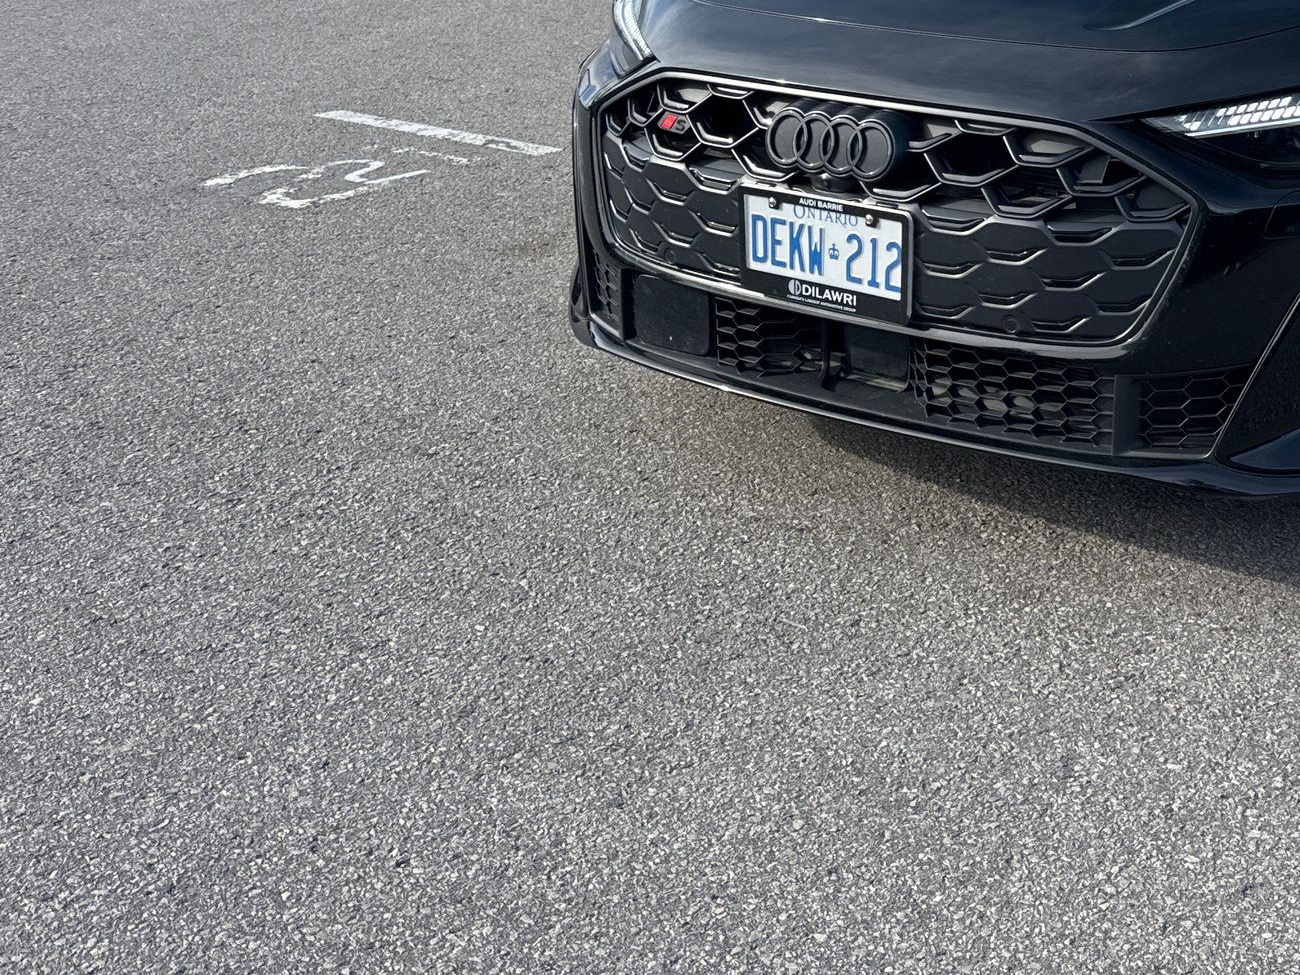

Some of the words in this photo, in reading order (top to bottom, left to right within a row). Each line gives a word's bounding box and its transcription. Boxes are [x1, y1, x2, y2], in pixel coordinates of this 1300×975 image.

[793, 204, 858, 228] ONTARIO
[799, 197, 816, 207] AUDI
[817, 200, 844, 212] BARRIE
[846, 233, 901, 293] 212
[801, 284, 857, 306] DILAWRI
